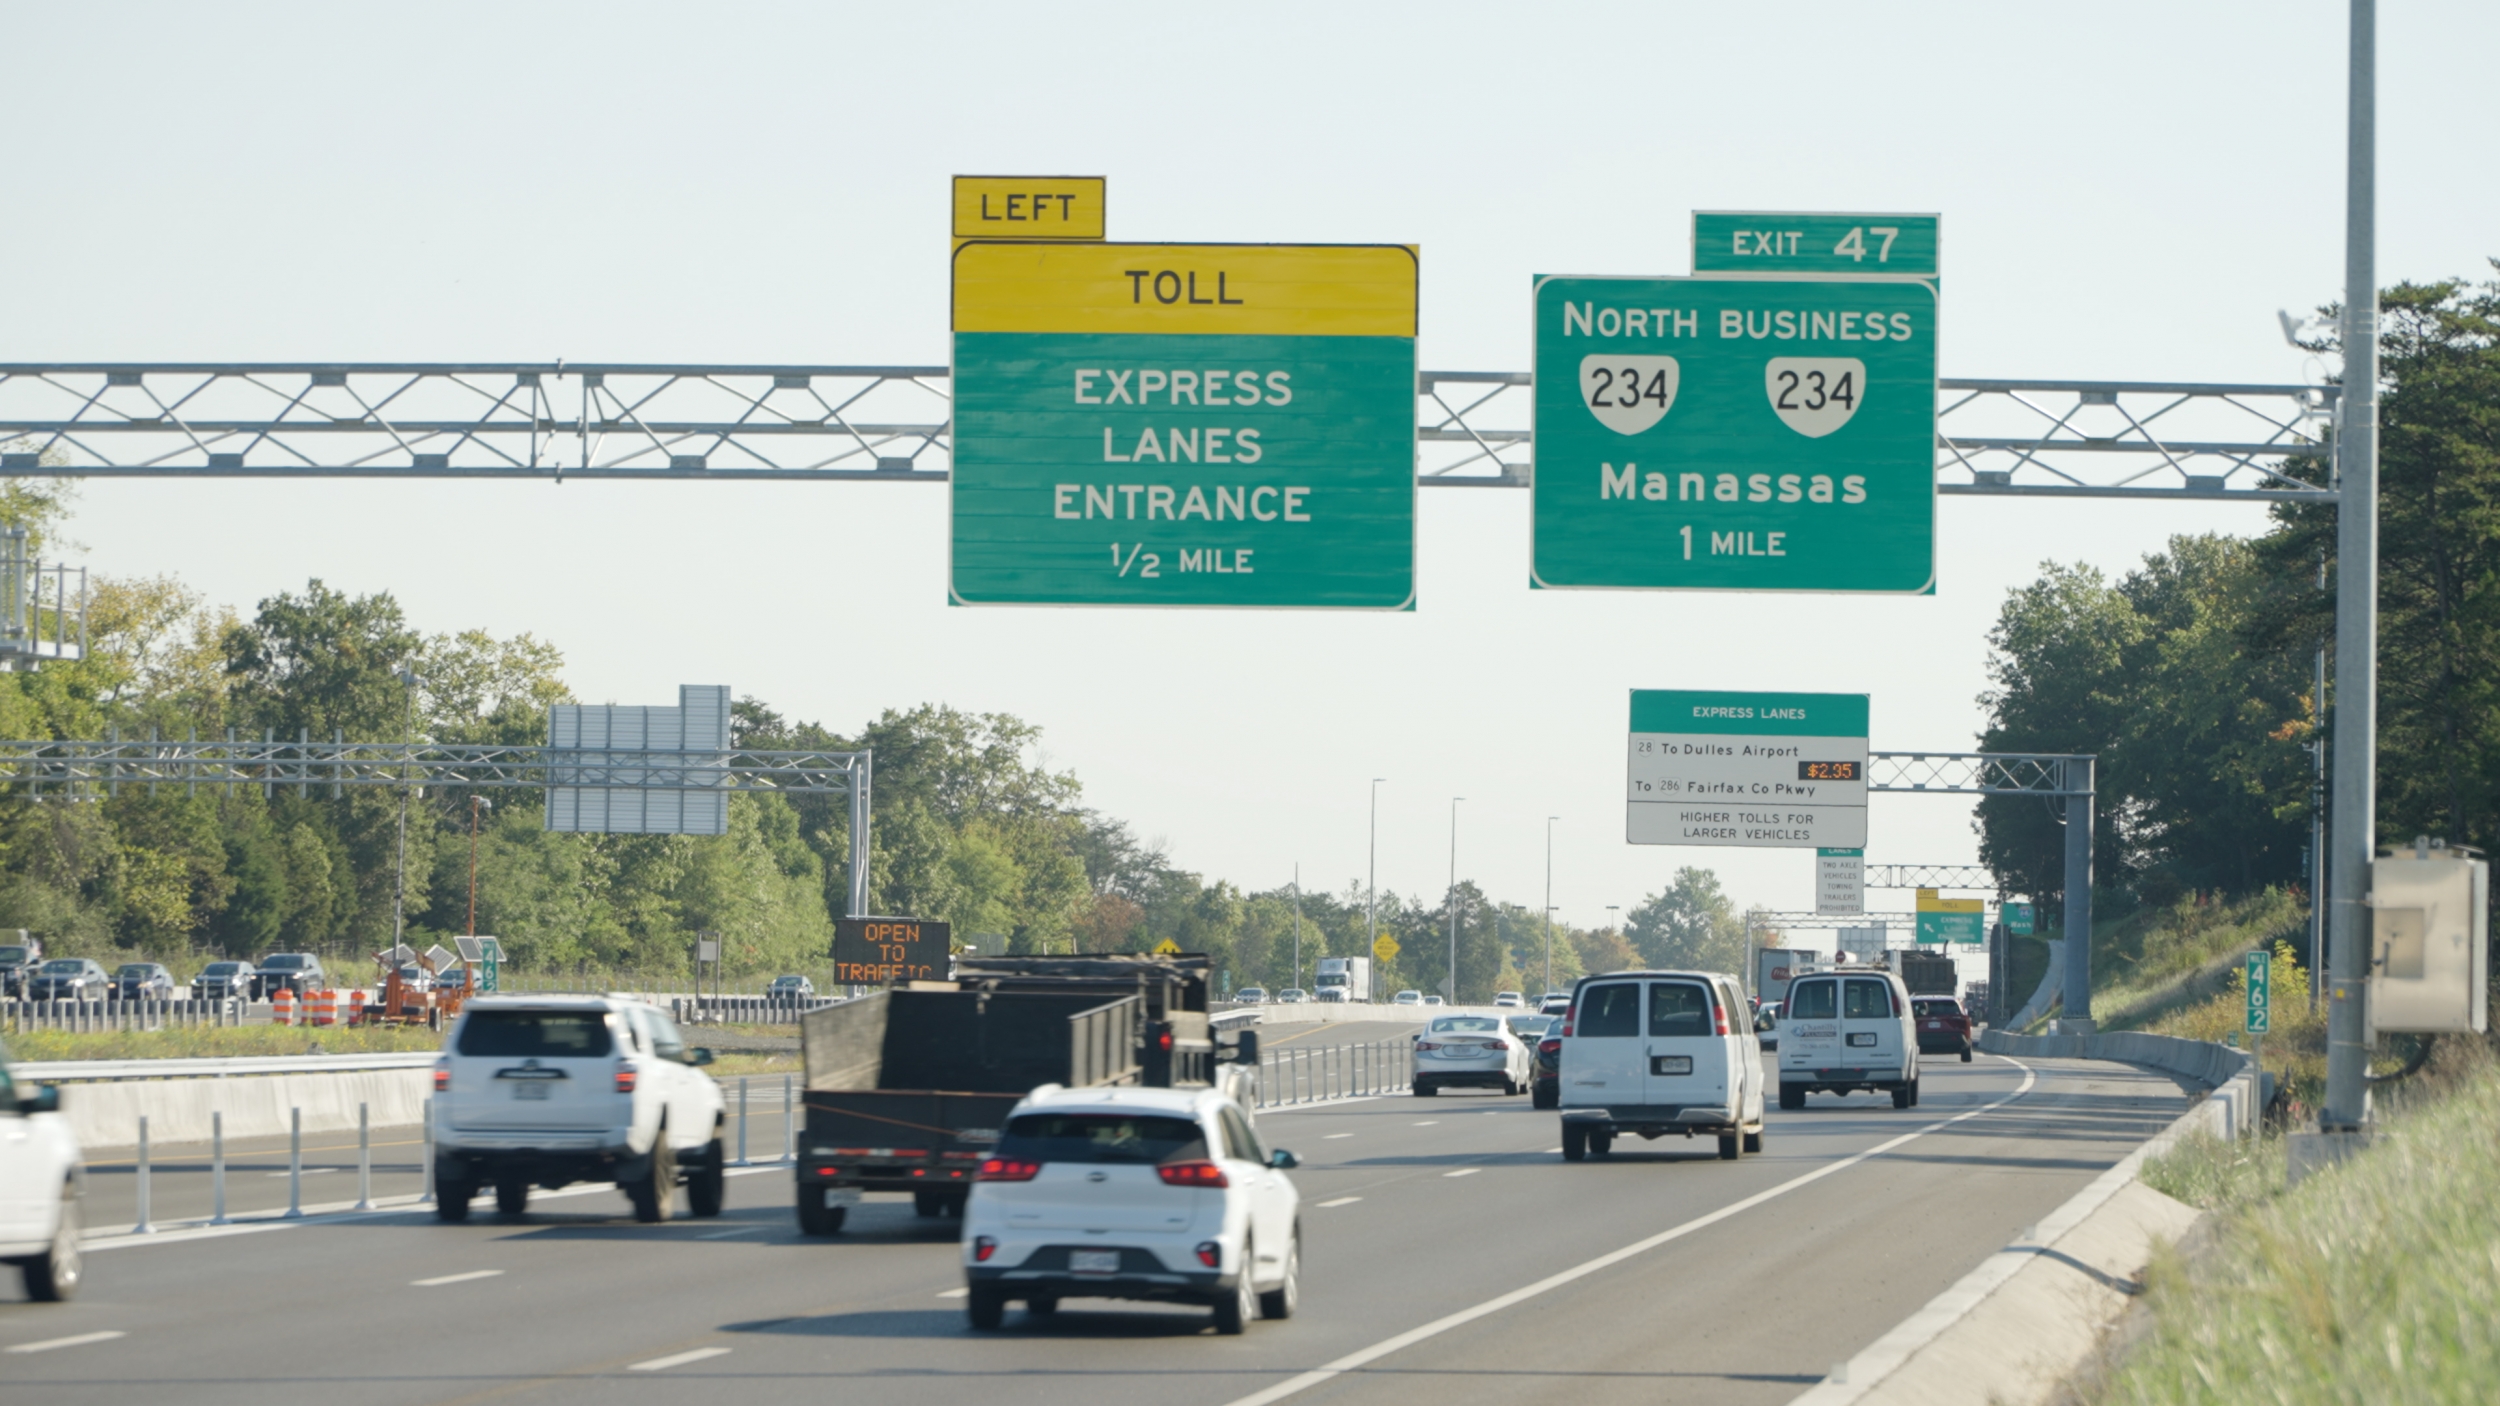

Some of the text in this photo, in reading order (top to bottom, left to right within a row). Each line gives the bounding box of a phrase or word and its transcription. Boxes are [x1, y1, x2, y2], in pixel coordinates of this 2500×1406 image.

[981, 194, 1076, 221] LEFT
[1733, 227, 1899, 262] EXIT 47
[1125, 270, 1244, 305] TOLL
[1563, 301, 1912, 341] NORTH BUSINESS
[1074, 369, 1293, 406] EXPRESS
[1590, 368, 1667, 408] 234
[1776, 370, 1854, 410] 234
[1103, 427, 1263, 464] LANES
[1601, 462, 1867, 504] Manassas
[1053, 484, 1311, 522] ENTRANCE
[1680, 525, 1786, 560] 1 MILE
[1180, 548, 1254, 573] MILE
[1693, 706, 1806, 719] EXPRESS LANES
[1638, 742, 1799, 759] 28 To Dulles Airport
[1635, 780, 1816, 798] To 286 Fairfax Co Pkwy
[1680, 812, 1813, 824] HIGHER TOLLS FOR
[1683, 827, 1810, 840] LARGER VEHICLES
[1823, 872, 1857, 880] VEHICLES
[865, 924, 920, 942] OPEN
[879, 944, 905, 961] TO
